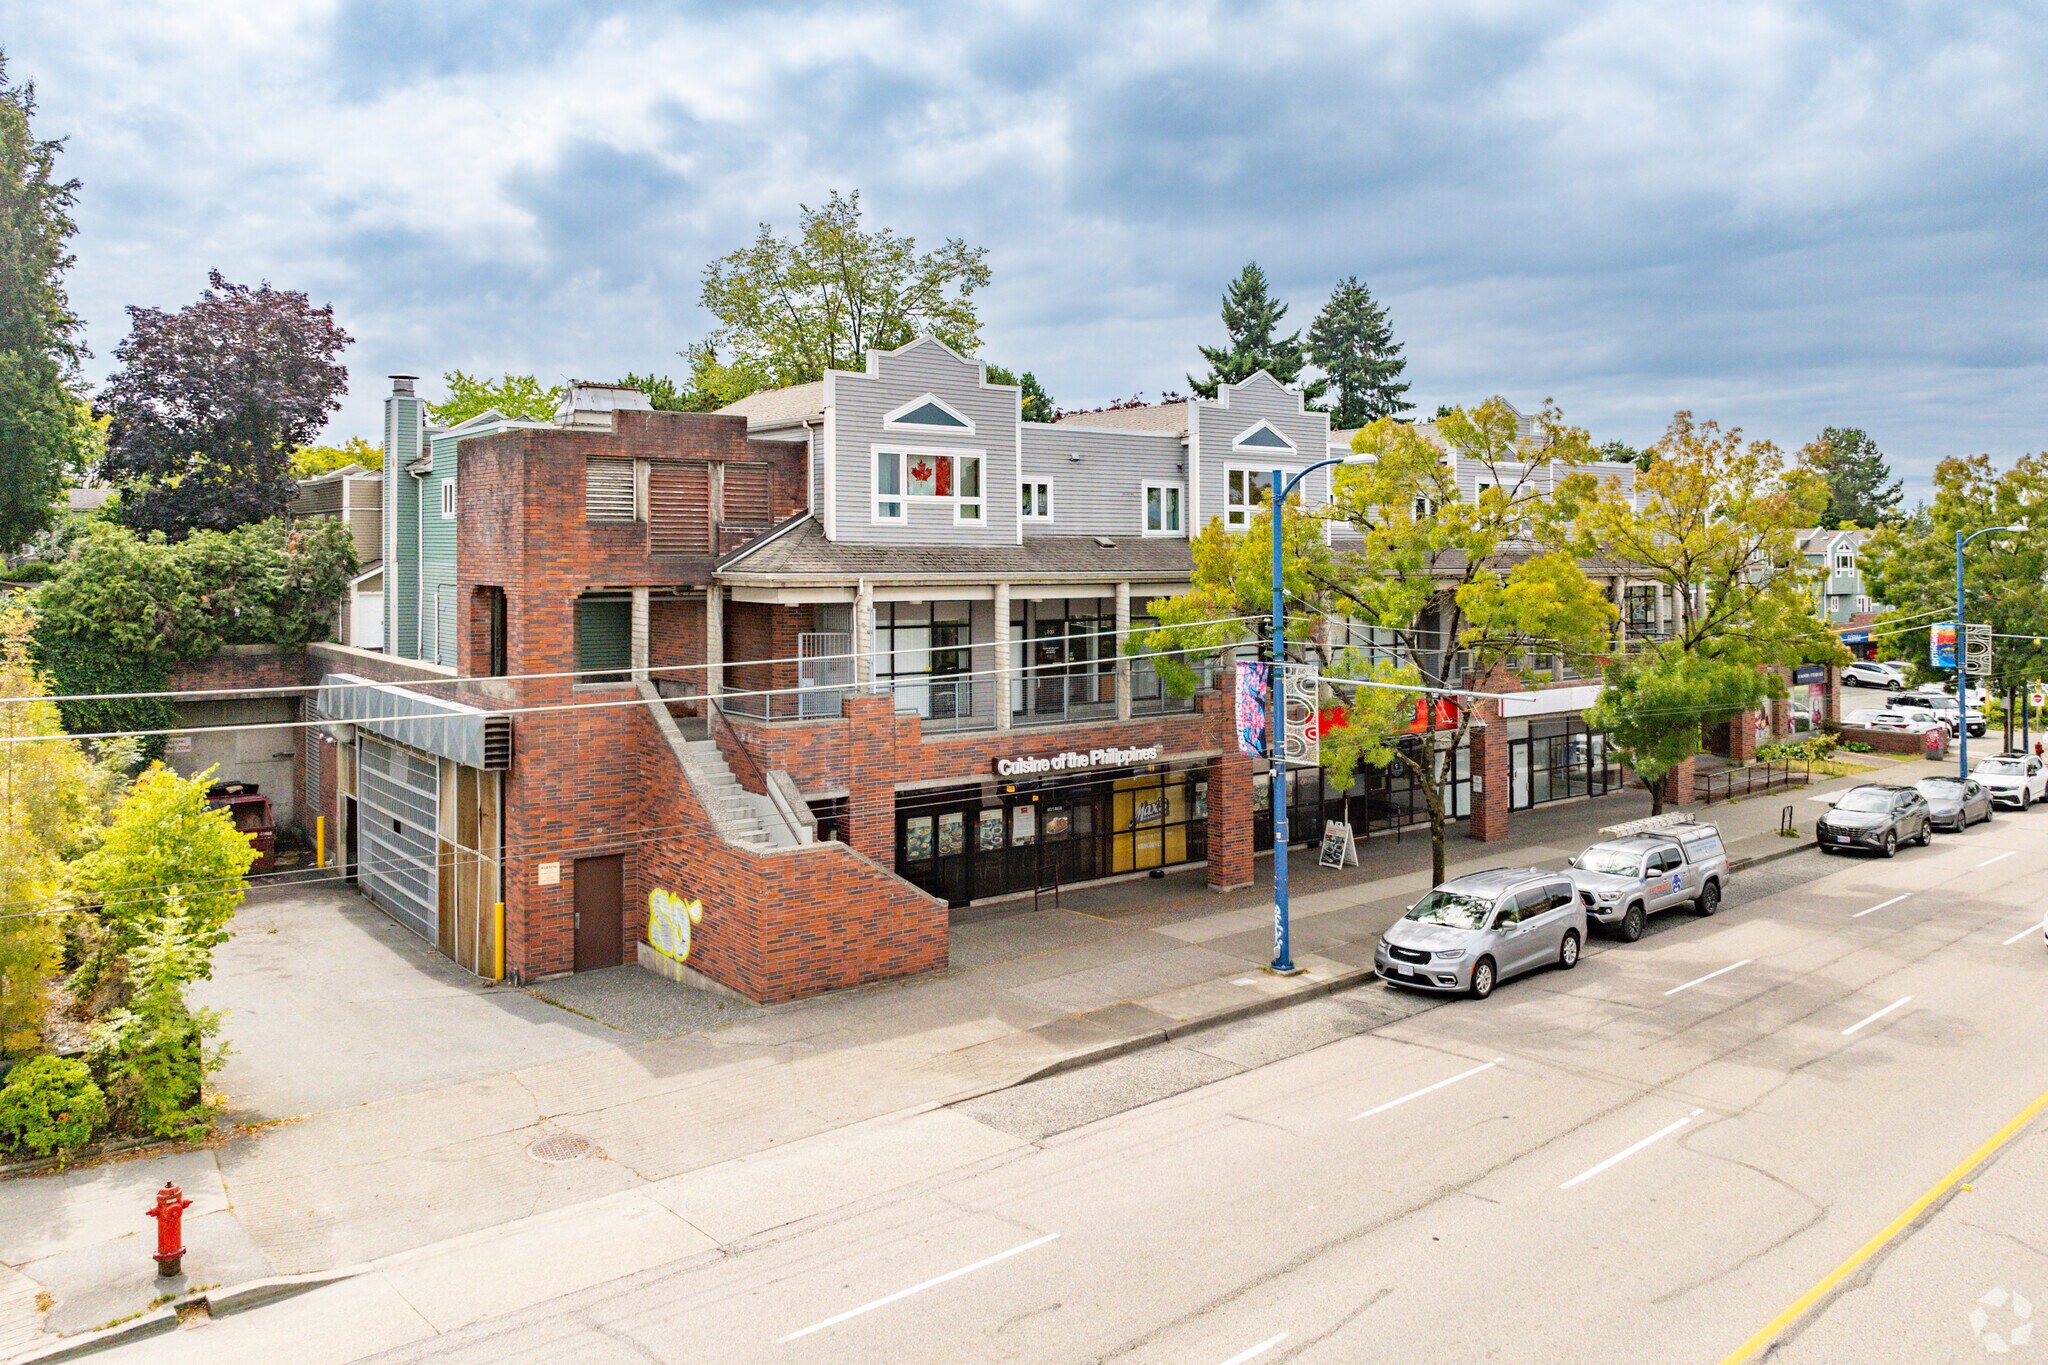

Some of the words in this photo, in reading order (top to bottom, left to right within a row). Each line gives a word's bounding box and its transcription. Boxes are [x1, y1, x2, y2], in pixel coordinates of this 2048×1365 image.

[998, 757, 1050, 776] Cuisine
[1051, 753, 1067, 770] of
[1066, 752, 1089, 768] the
[1090, 746, 1157, 767] Philippines
